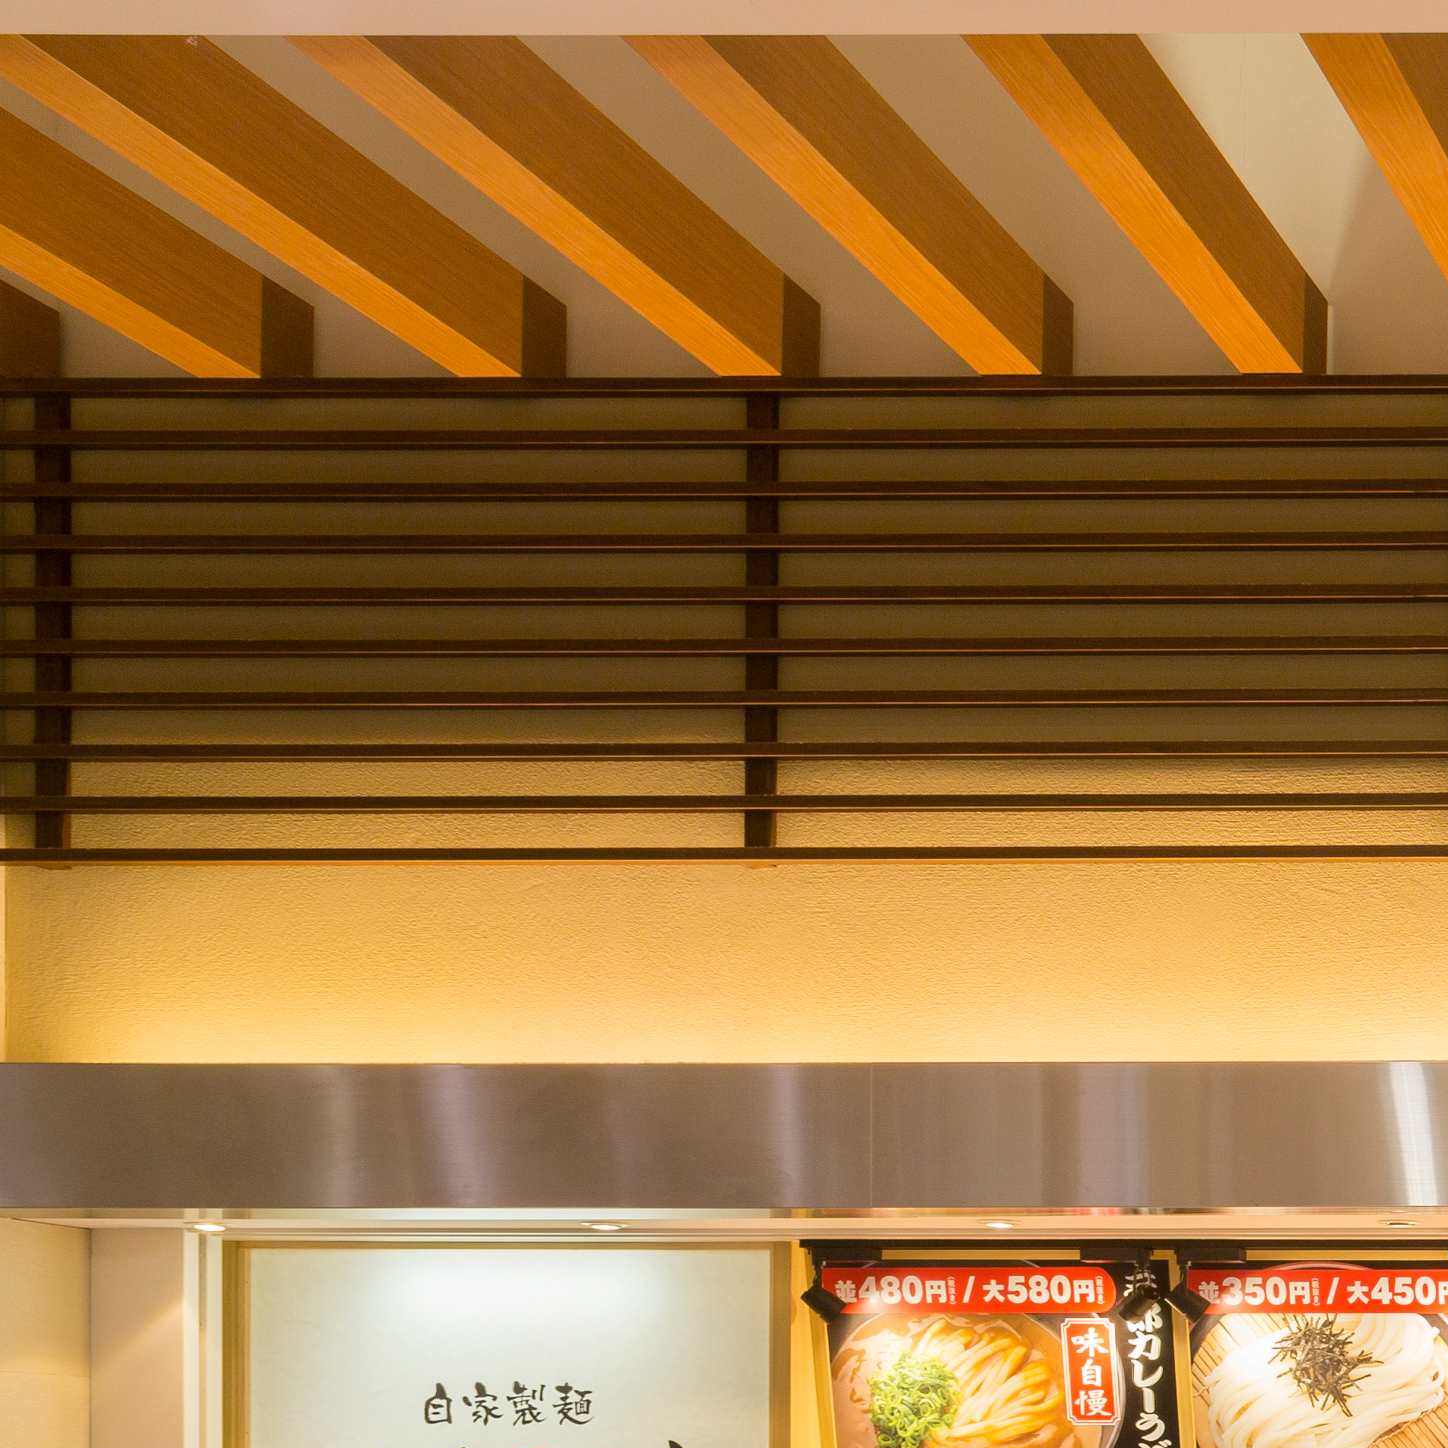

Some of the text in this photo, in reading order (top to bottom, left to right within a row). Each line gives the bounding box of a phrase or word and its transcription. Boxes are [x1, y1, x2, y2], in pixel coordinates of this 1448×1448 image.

[983, 1275, 1096, 1304] 大580円
[1071, 1327, 1112, 1417] 味自慢
[423, 1380, 596, 1426] 自家製麺
